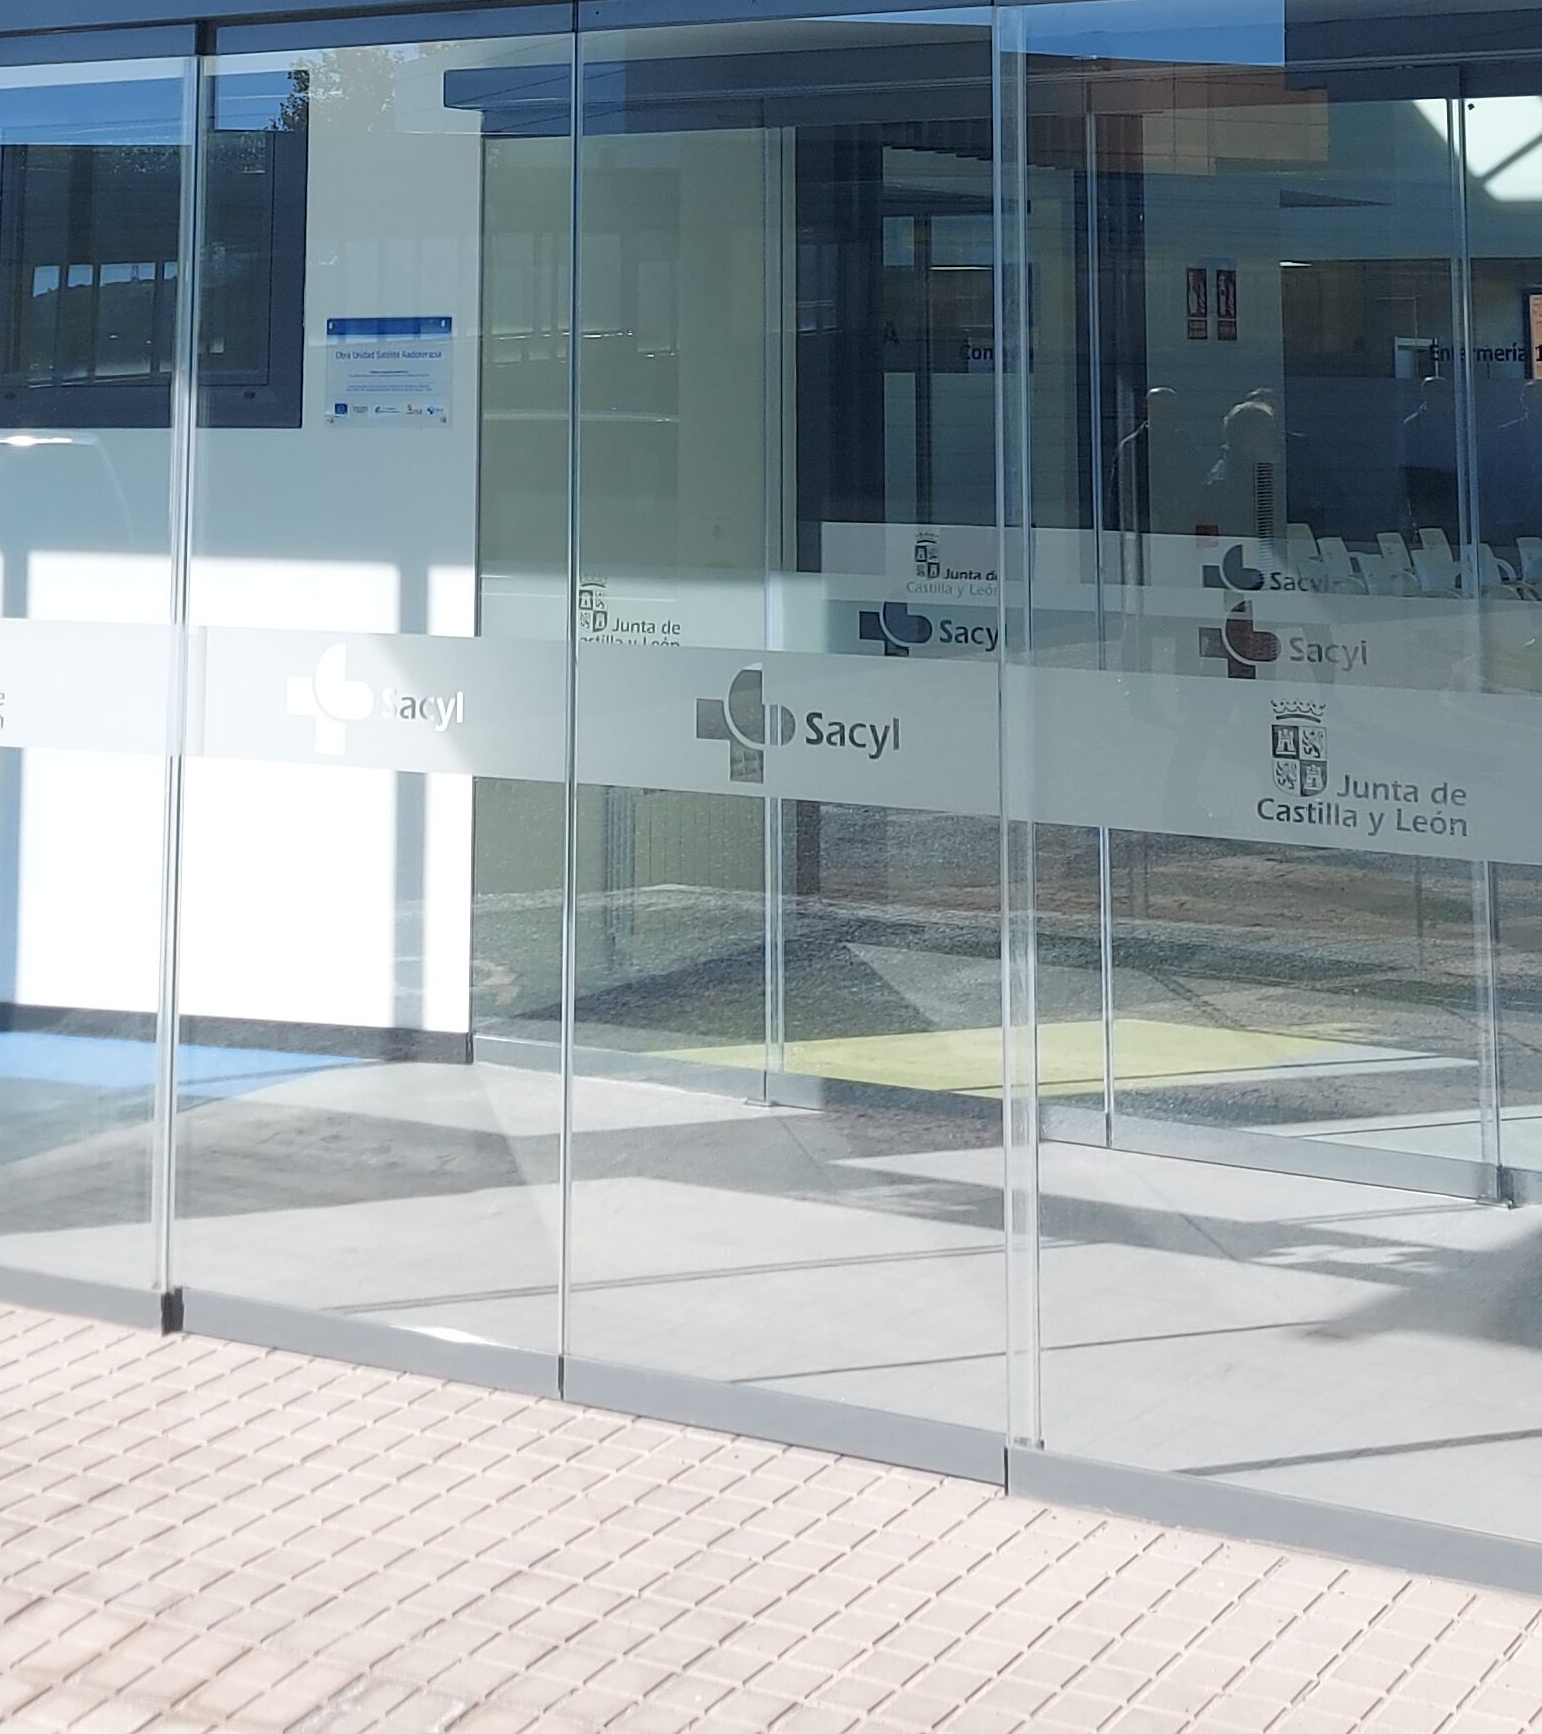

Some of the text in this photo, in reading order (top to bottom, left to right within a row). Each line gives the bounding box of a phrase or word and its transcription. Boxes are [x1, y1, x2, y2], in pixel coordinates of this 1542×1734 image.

[906, 581, 953, 595] Castilla
[943, 568, 982, 581] Junta
[611, 617, 681, 635] Junta de
[939, 619, 1008, 652] Sacyl
[381, 687, 464, 732] Sacyl
[805, 712, 900, 760] Sacyl
[1336, 774, 1467, 806] Junta de
[1256, 797, 1468, 837] Castilla y León
